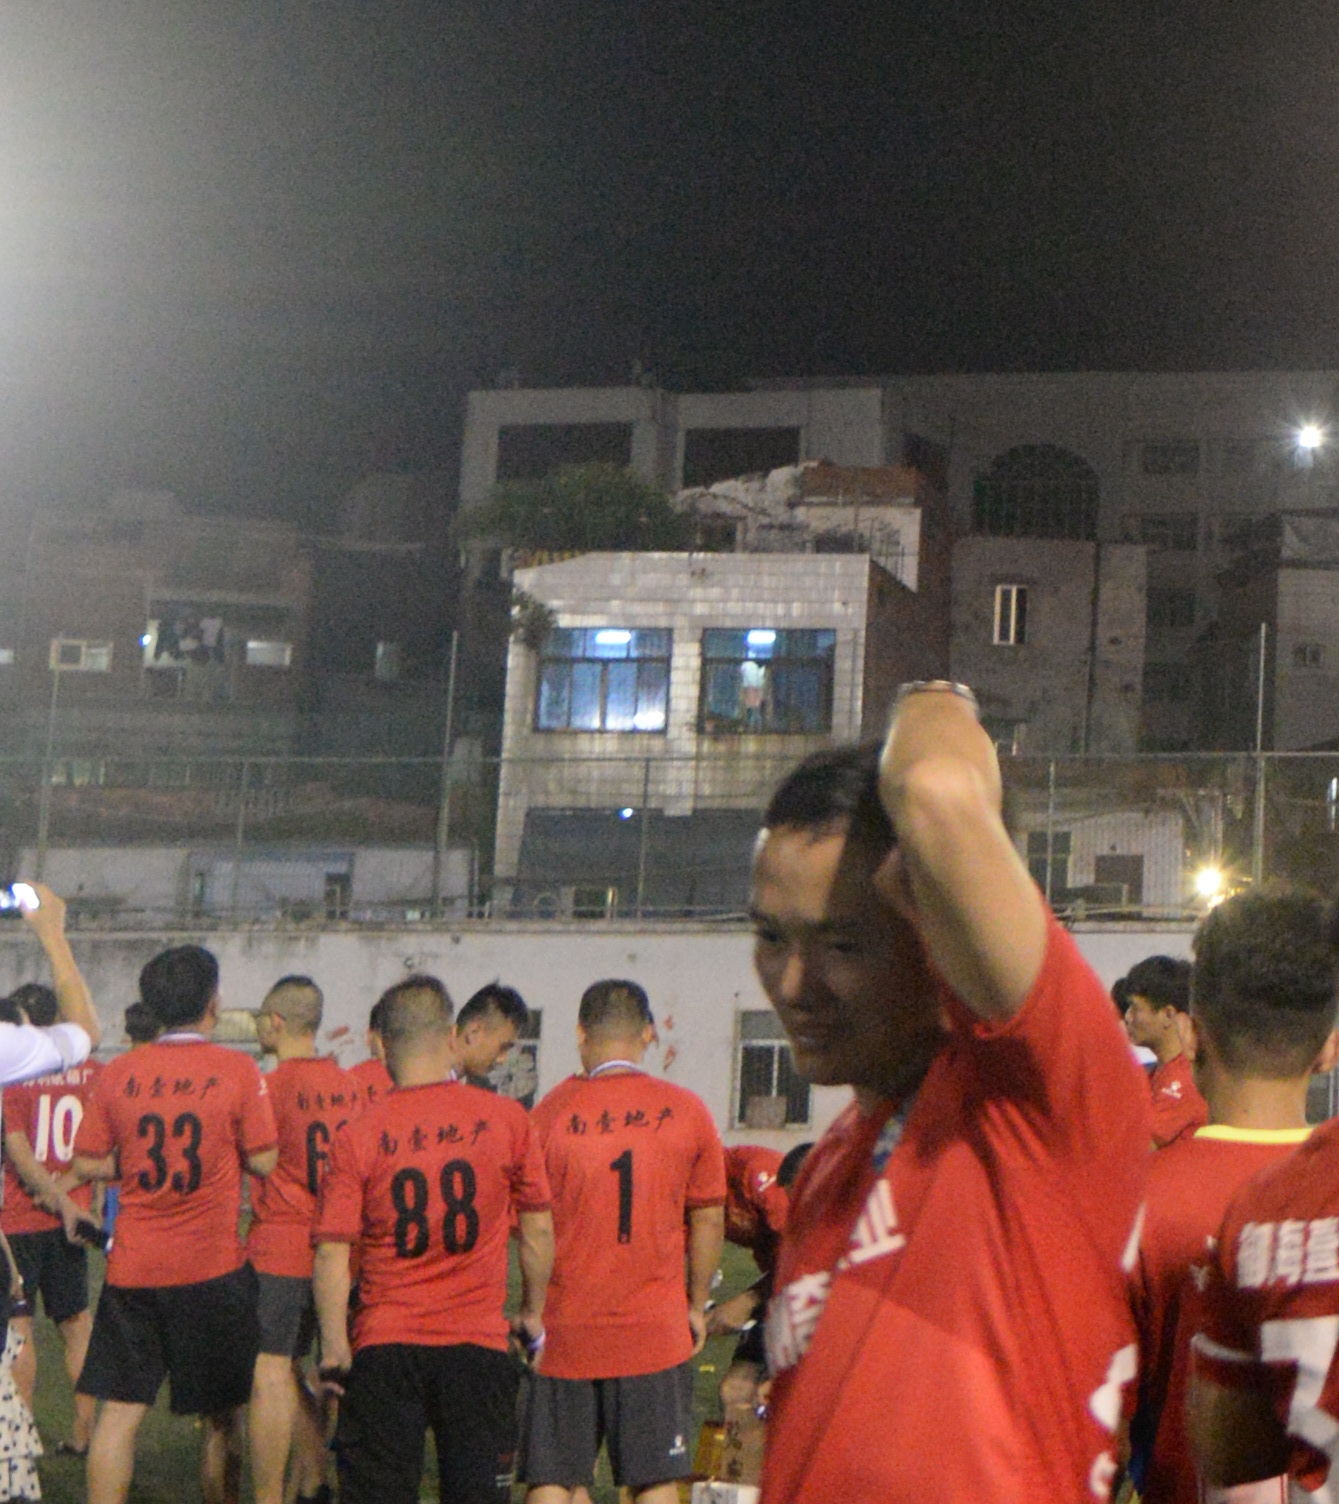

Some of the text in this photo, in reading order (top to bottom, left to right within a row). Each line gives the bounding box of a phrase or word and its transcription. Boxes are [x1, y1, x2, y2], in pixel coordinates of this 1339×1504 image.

[34, 1093, 84, 1162] 10
[137, 1111, 202, 1193] 33
[390, 1158, 480, 1259] 88
[610, 1148, 633, 1244] 1
